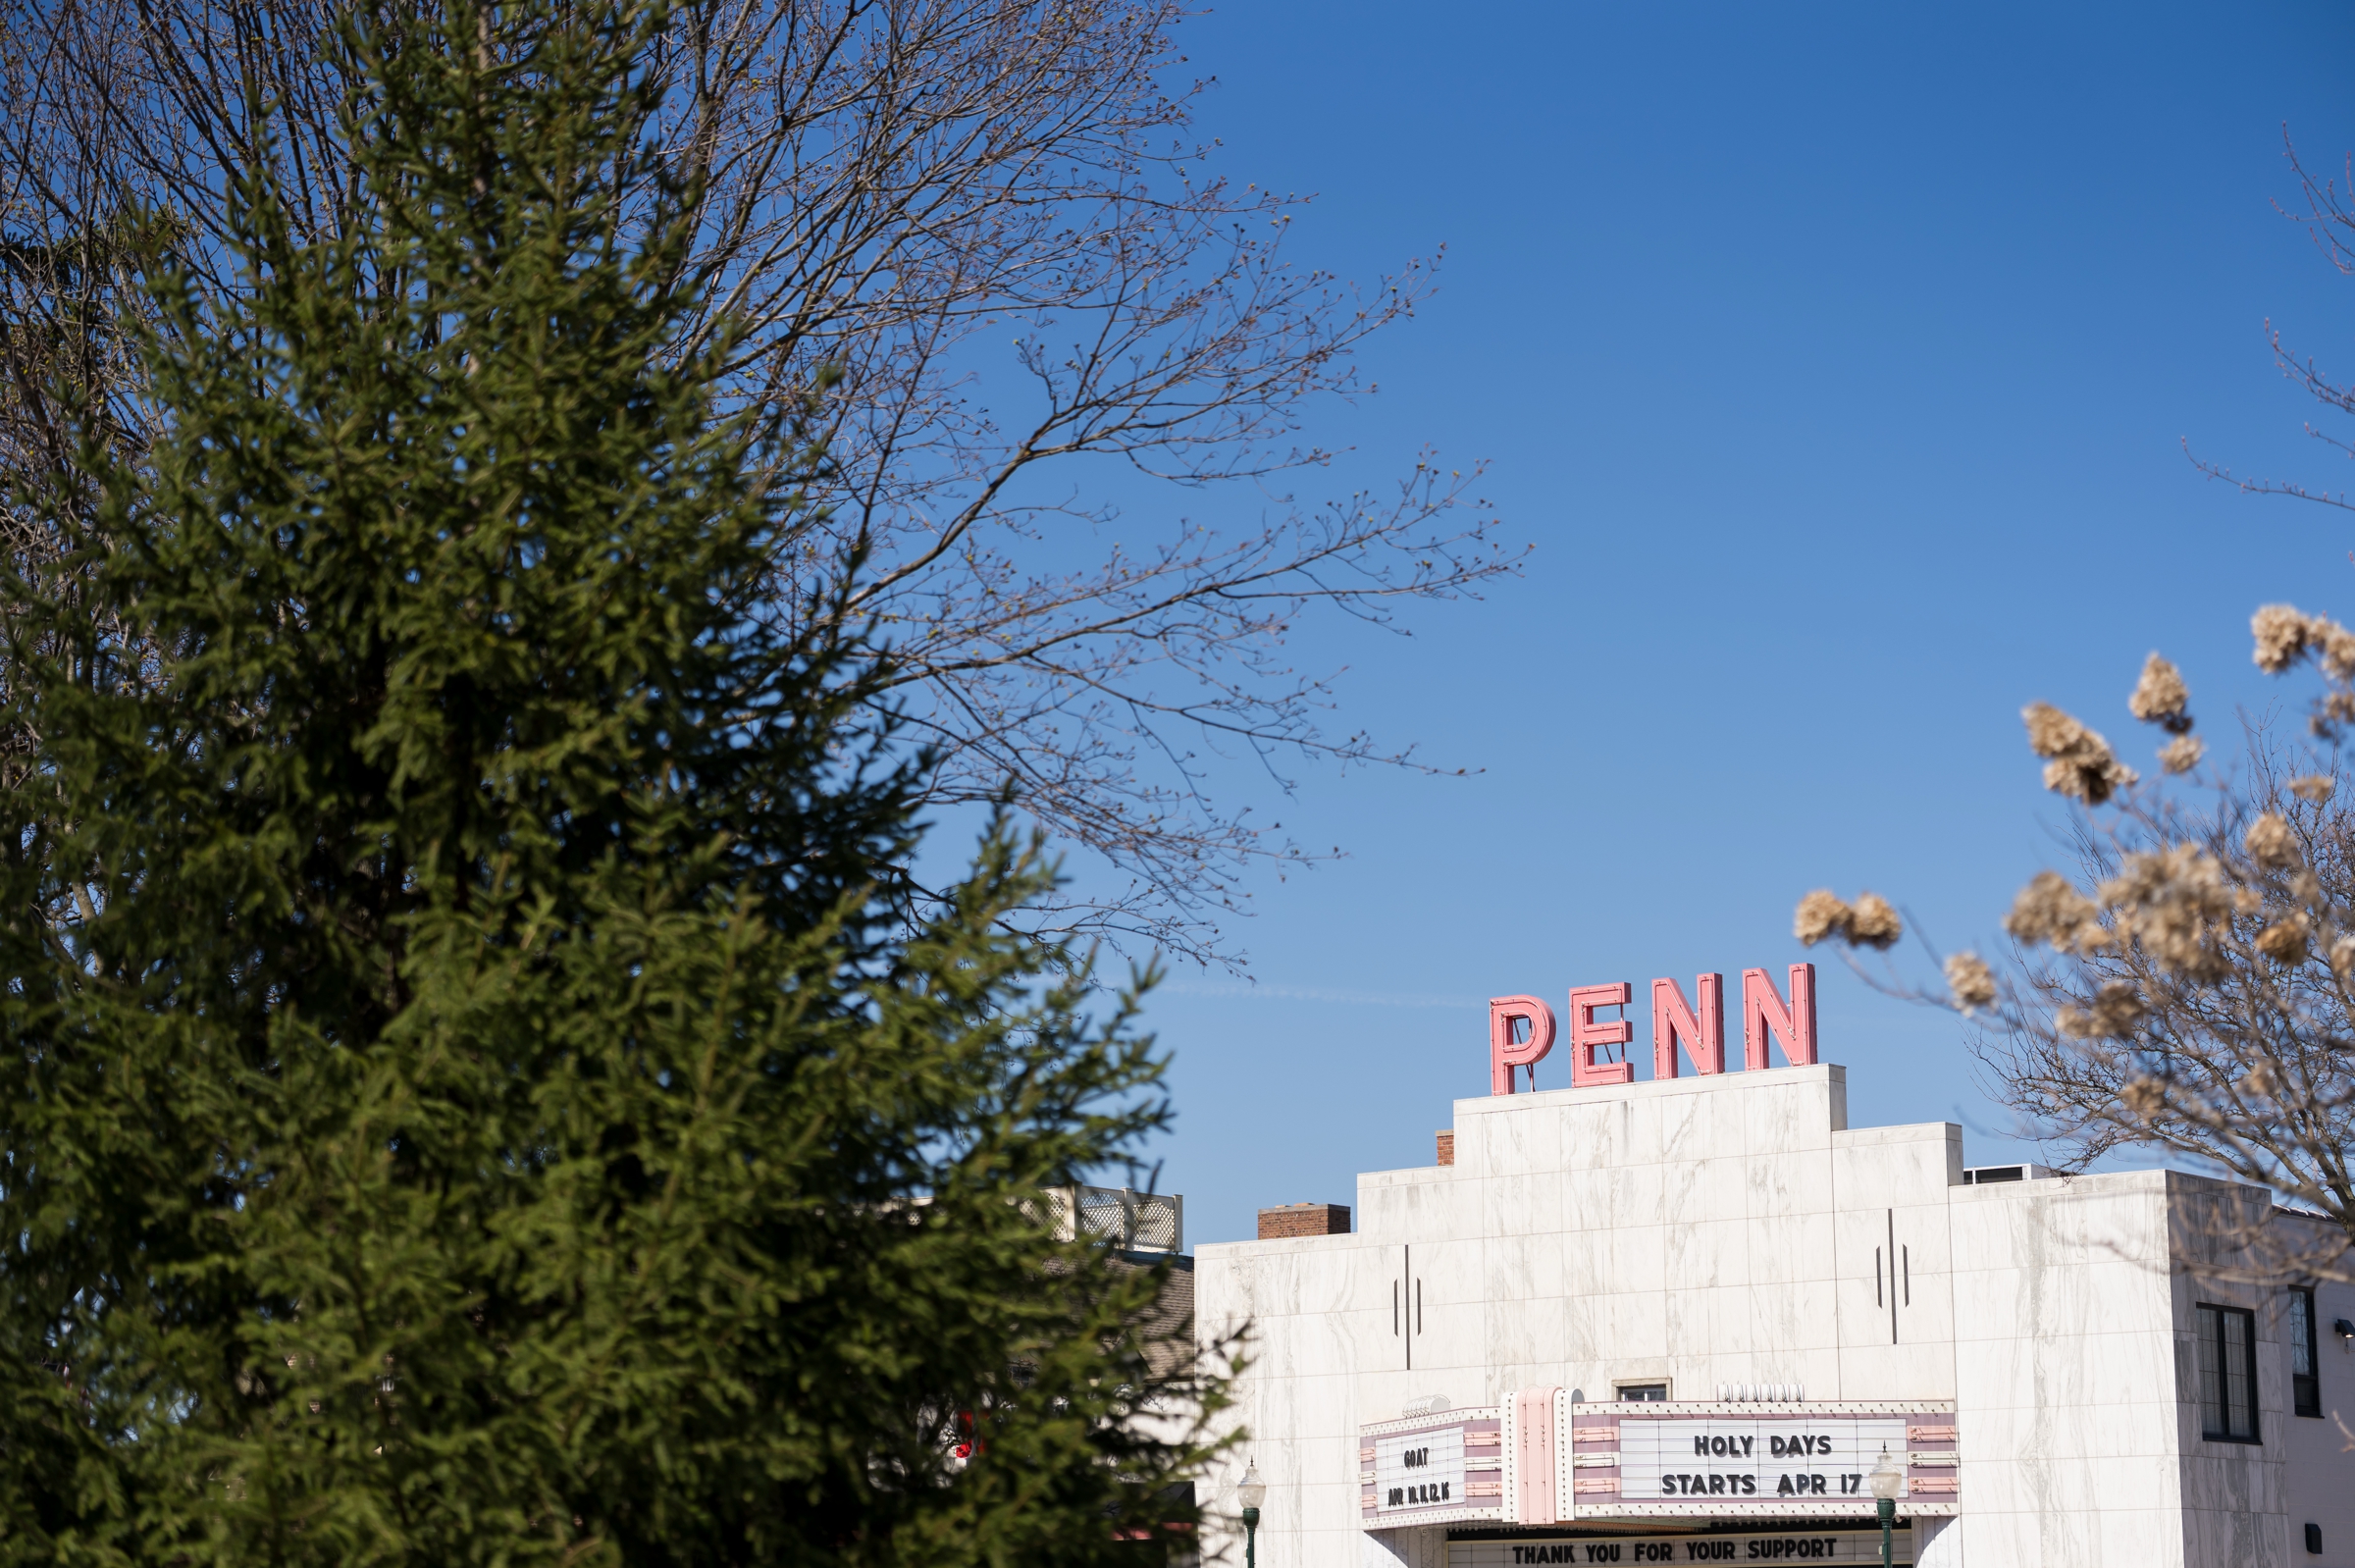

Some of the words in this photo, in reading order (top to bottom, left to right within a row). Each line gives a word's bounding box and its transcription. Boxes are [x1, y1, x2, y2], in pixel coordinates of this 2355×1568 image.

[1490, 963, 1818, 1097] PENN
[1694, 1435, 1754, 1456] HOLY
[1770, 1435, 1832, 1455] DAYS
[1404, 1447, 1429, 1468] GOAT
[1661, 1474, 1756, 1494] STARTS
[1777, 1474, 1827, 1494] APR
[1840, 1474, 1862, 1494] 17
[1388, 1488, 1403, 1506] APR
[1512, 1544, 1576, 1564] THANK
[1586, 1543, 1621, 1563] YOU
[1634, 1542, 1673, 1562] FOR
[1686, 1541, 1736, 1561] YOUR
[1748, 1538, 1837, 1559] SUPPORT
